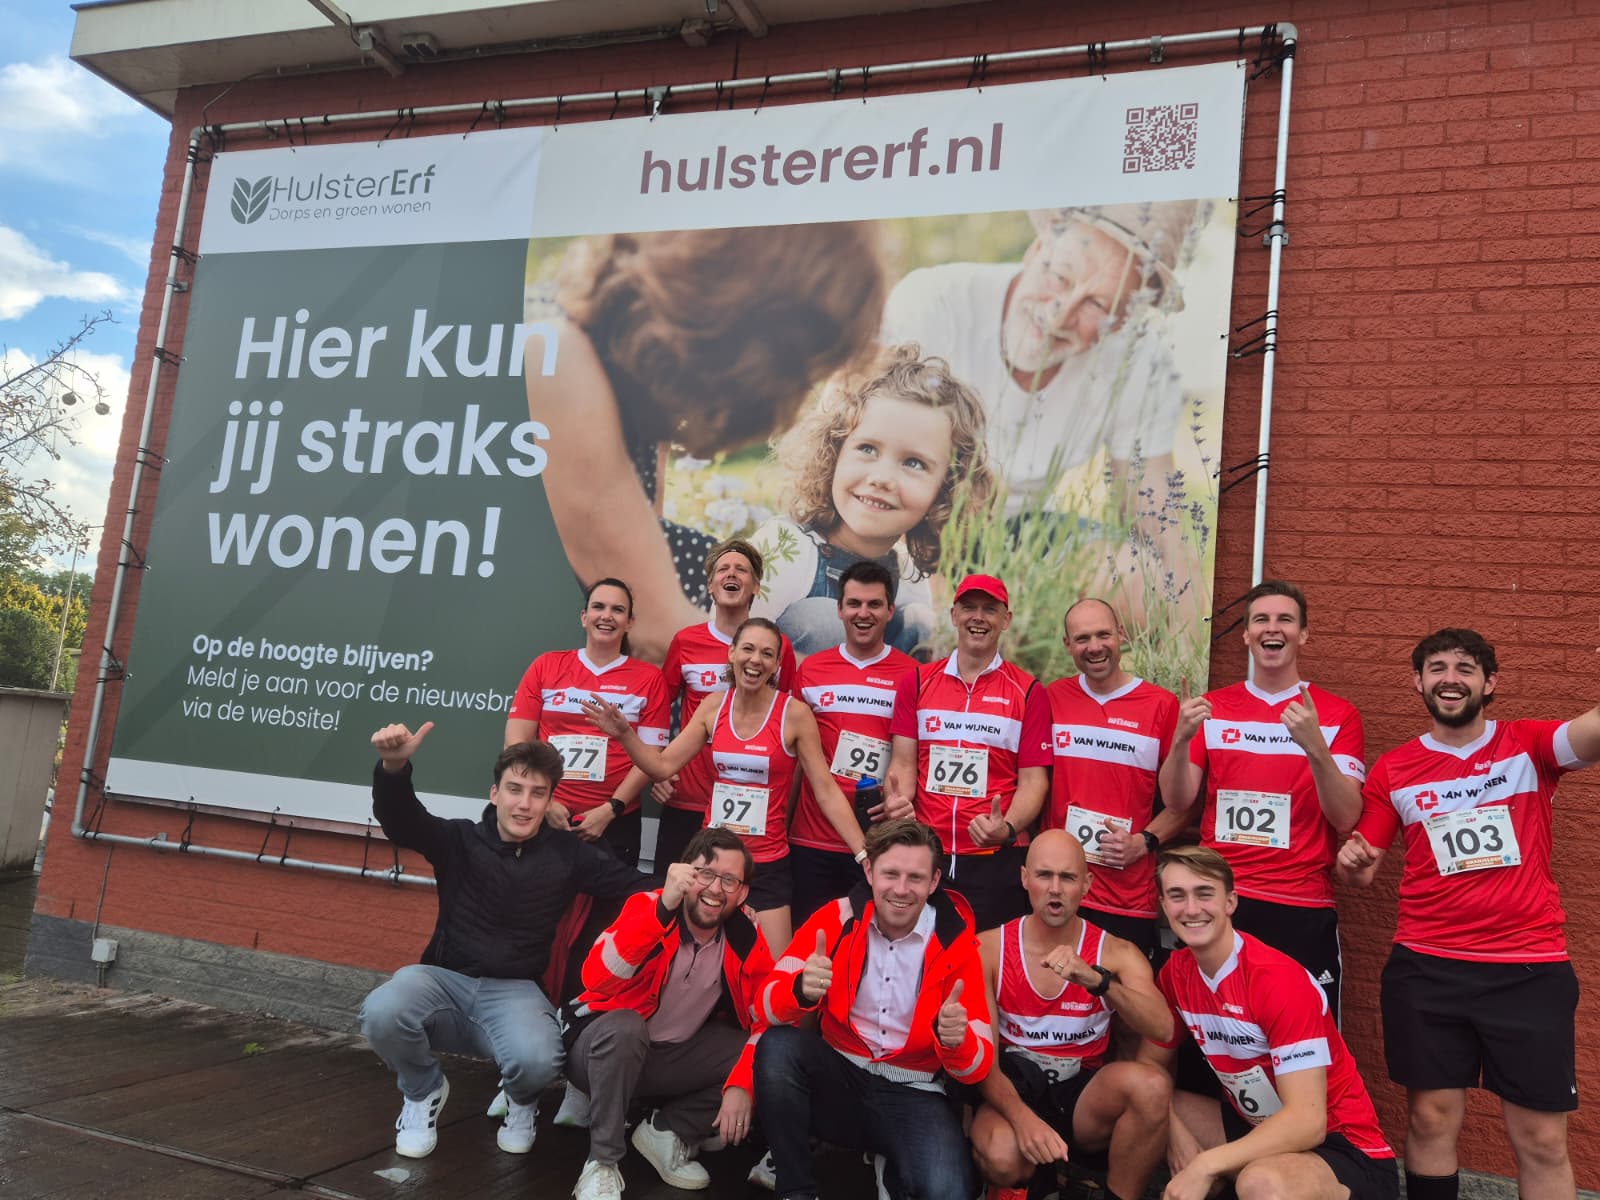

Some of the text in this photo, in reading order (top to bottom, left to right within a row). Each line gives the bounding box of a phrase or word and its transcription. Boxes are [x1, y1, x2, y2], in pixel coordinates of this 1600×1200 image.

[640, 123, 1003, 194] hulstererf.nl
[272, 164, 436, 202] HulsterErf
[269, 201, 431, 222] Dorps en groen wonen
[234, 308, 559, 379] Hier kun
[209, 400, 550, 494] jij straks
[208, 506, 501, 578] wonen!
[192, 634, 434, 674] Op de hoogte blijven?
[187, 665, 517, 712] Meld je aan voor de nieuwsbr
[837, 695, 892, 708] VAN WIJNEN
[182, 696, 341, 731] via de website!
[944, 721, 1001, 735] VAN WIJNEN
[1244, 732, 1298, 745] VAN WIJN
[559, 747, 599, 769] 77
[1073, 736, 1136, 753] VAN WIJNEN
[849, 748, 880, 772] 95
[934, 760, 979, 785] 676
[722, 798, 752, 822] 97
[1226, 805, 1276, 834] 102
[1442, 824, 1503, 858] 103
[1026, 1027, 1096, 1041] VAN WIJNEN
